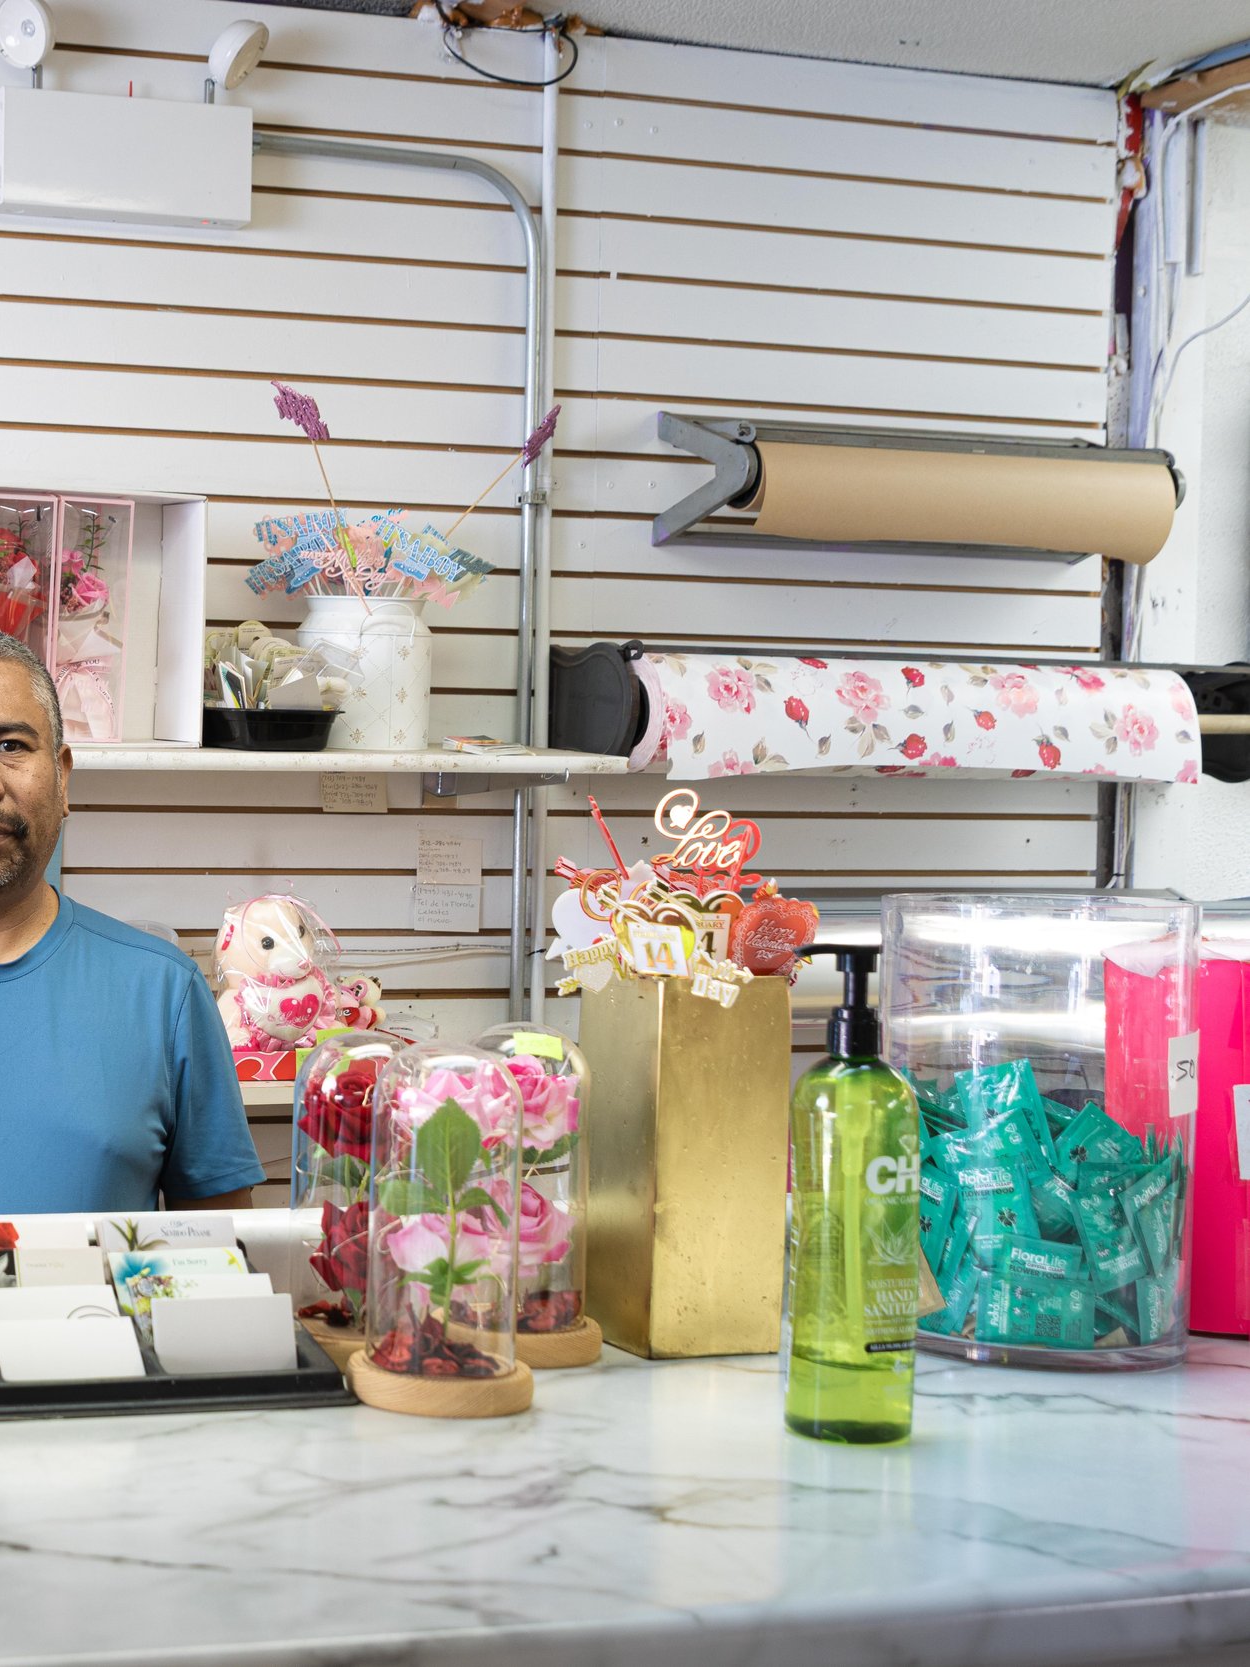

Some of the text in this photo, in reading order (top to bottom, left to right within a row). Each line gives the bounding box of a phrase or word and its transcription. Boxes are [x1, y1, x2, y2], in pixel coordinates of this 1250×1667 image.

[375, 518, 412, 554] IT'S
[417, 544, 467, 584] BOY
[652, 788, 742, 868] Love
[414, 898, 428, 906] Tel
[430, 900, 440, 908] de
[757, 918, 797, 940] Happy
[563, 938, 619, 970] Happy
[642, 941, 677, 971] 14
[1170, 1059, 1196, 1082] .50
[961, 1187, 1015, 1198] FLOWER FOOD
[186, 1258, 208, 1267] Sorry
[1010, 1247, 1068, 1268] FloraLife
[1009, 1264, 1066, 1280] FLOWER FOOD
[875, 1288, 915, 1303] HAND
